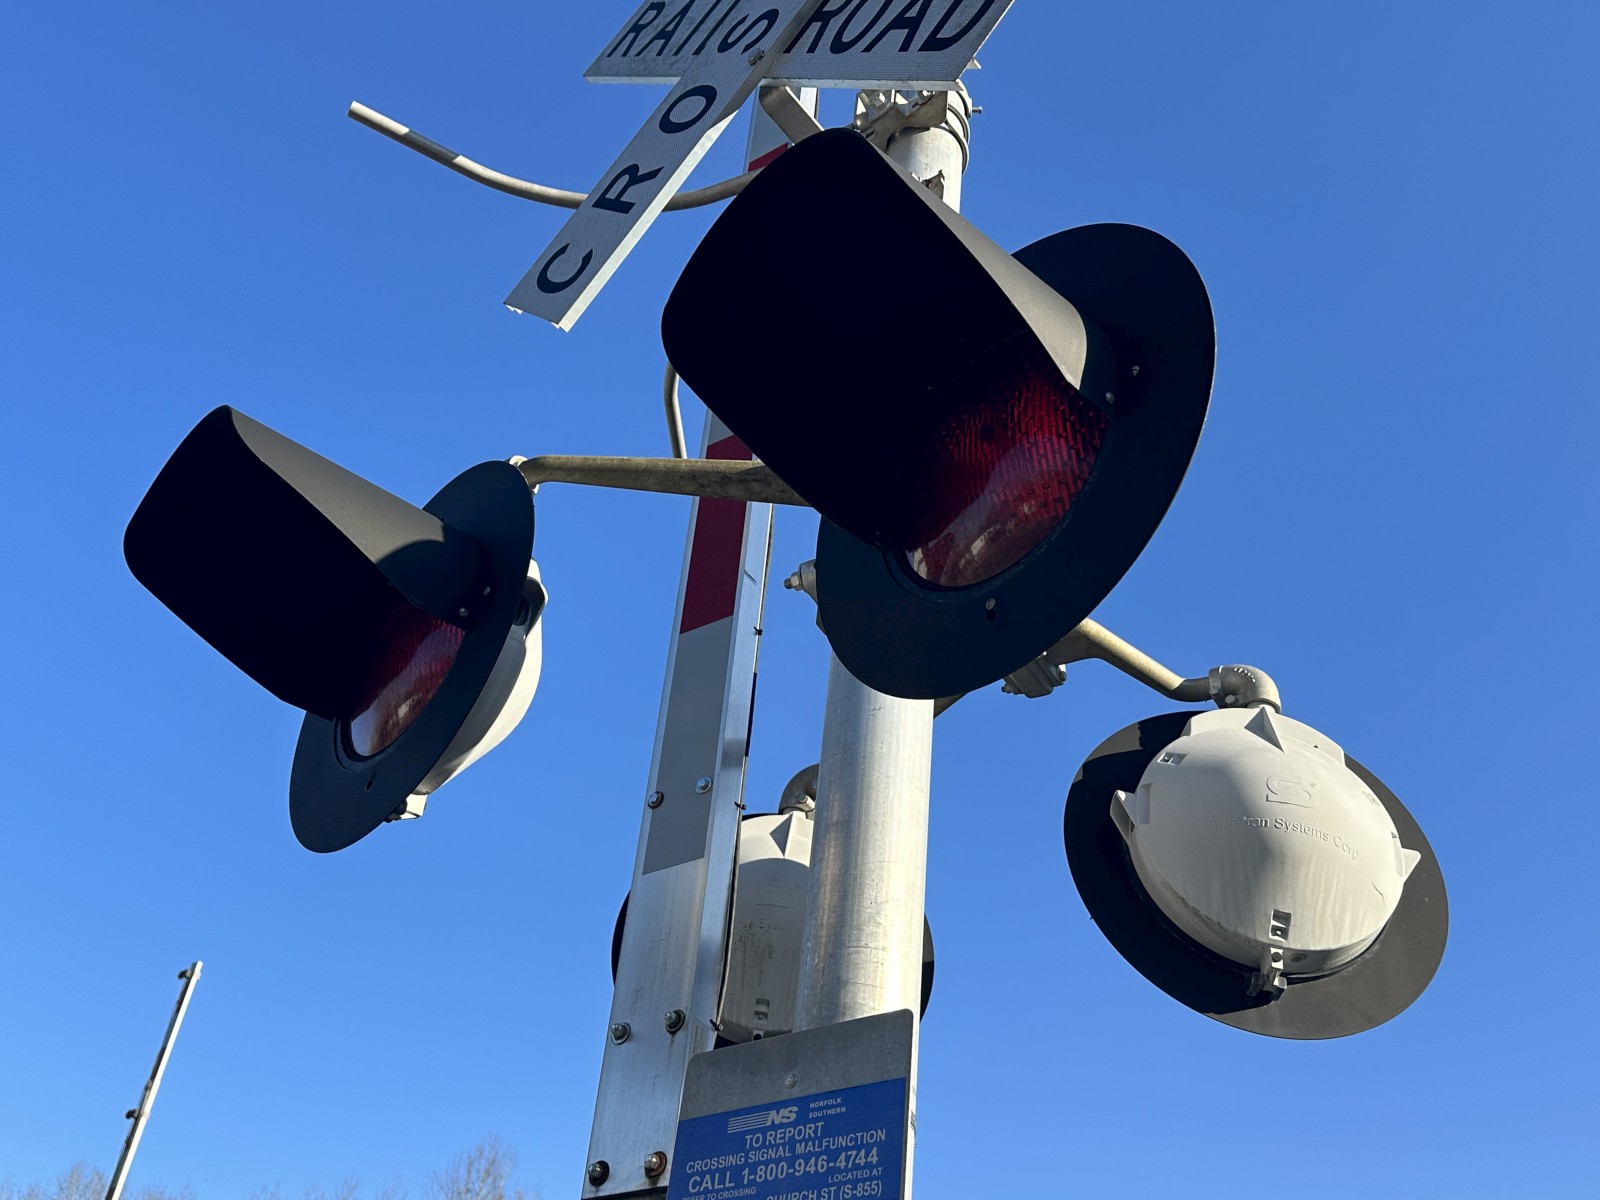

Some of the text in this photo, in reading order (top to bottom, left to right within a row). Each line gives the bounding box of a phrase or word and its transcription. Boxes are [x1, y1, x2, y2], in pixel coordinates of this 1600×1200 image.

[782, 0, 996, 54] ROAD
[1274, 816, 1329, 842] Systems
[809, 1097, 842, 1109] NORFOLK
[766, 1106, 846, 1126] NS SOUTHERN
[745, 1122, 824, 1149] TO REPORT
[686, 1128, 886, 1174] CROSSING SIGNAL MALFUNCTION
[688, 1146, 878, 1193] CALL 1-800-946-4744
[828, 1167, 883, 1183] LOCATED AT
[707, 1192, 717, 1200] TO
[718, 1187, 757, 1199] CROSSING
[820, 1186, 837, 1200] ST
[840, 1180, 882, 1200] (S-855)
